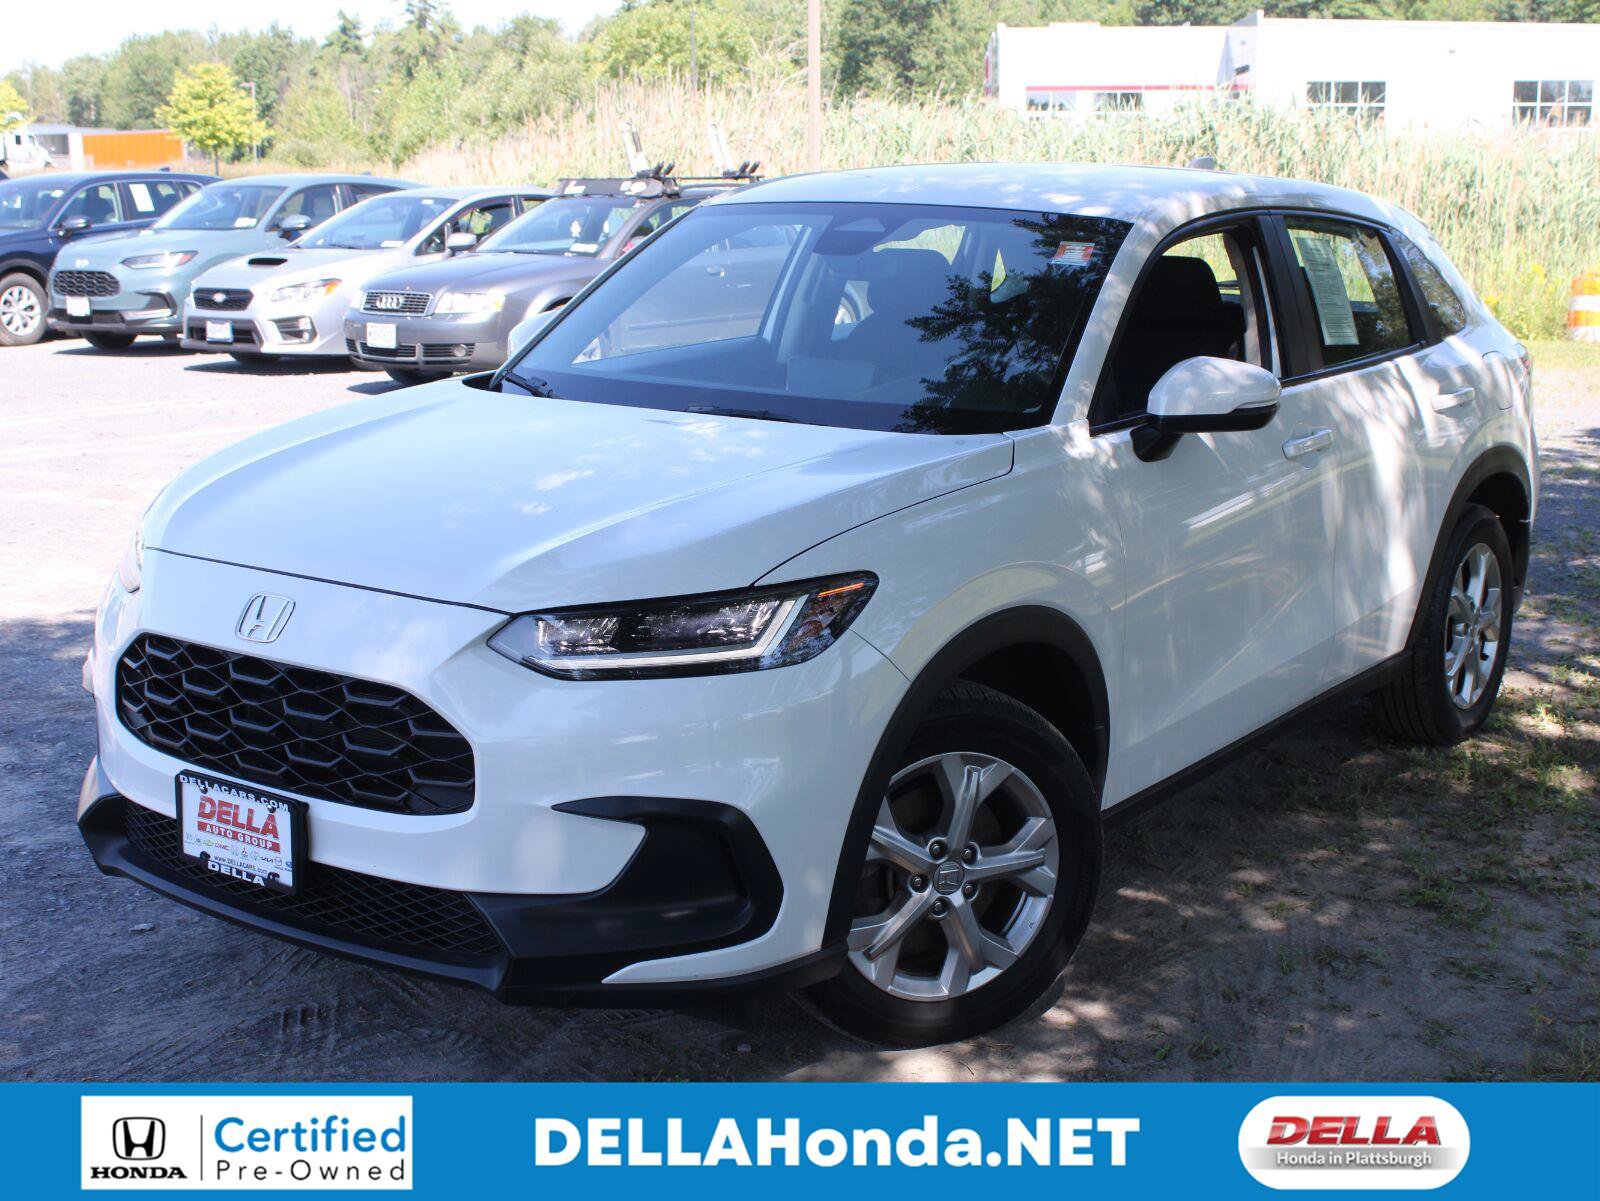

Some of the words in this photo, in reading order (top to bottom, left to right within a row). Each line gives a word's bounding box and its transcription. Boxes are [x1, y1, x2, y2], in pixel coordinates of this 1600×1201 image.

[179, 774, 290, 813] DELLACARS.COM
[197, 795, 280, 839] DELLA
[205, 824, 233, 838] AUTO
[237, 831, 274, 849] GROUP
[207, 860, 266, 887] DELLA
